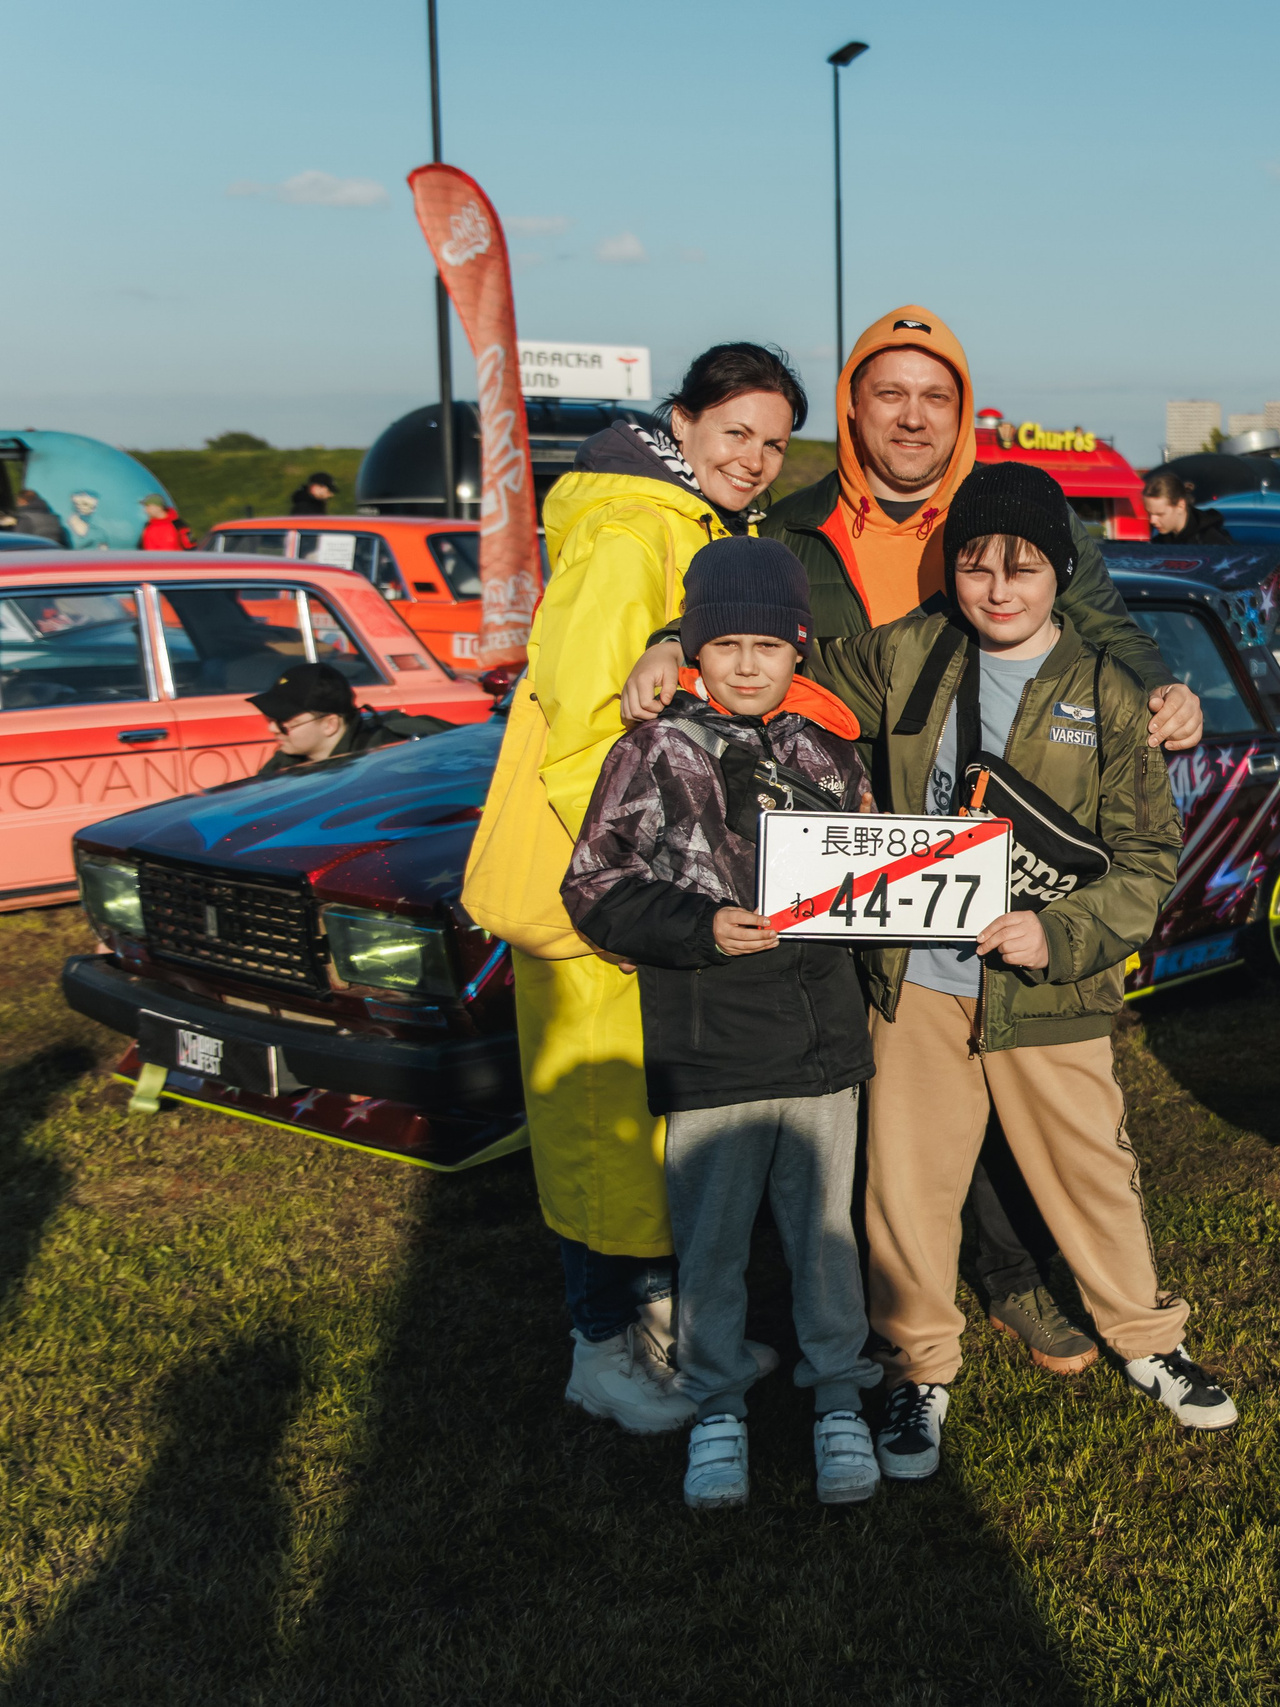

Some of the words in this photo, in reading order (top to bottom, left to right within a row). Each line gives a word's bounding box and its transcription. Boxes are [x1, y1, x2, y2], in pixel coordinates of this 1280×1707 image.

[1018, 422, 1096, 452] Churros
[1052, 727, 1096, 746] VARSITY
[0, 746, 268, 812] OYANOV
[821, 825, 956, 859] 長野882
[828, 871, 982, 929] 44-77
[198, 1053, 221, 1076] FEST
